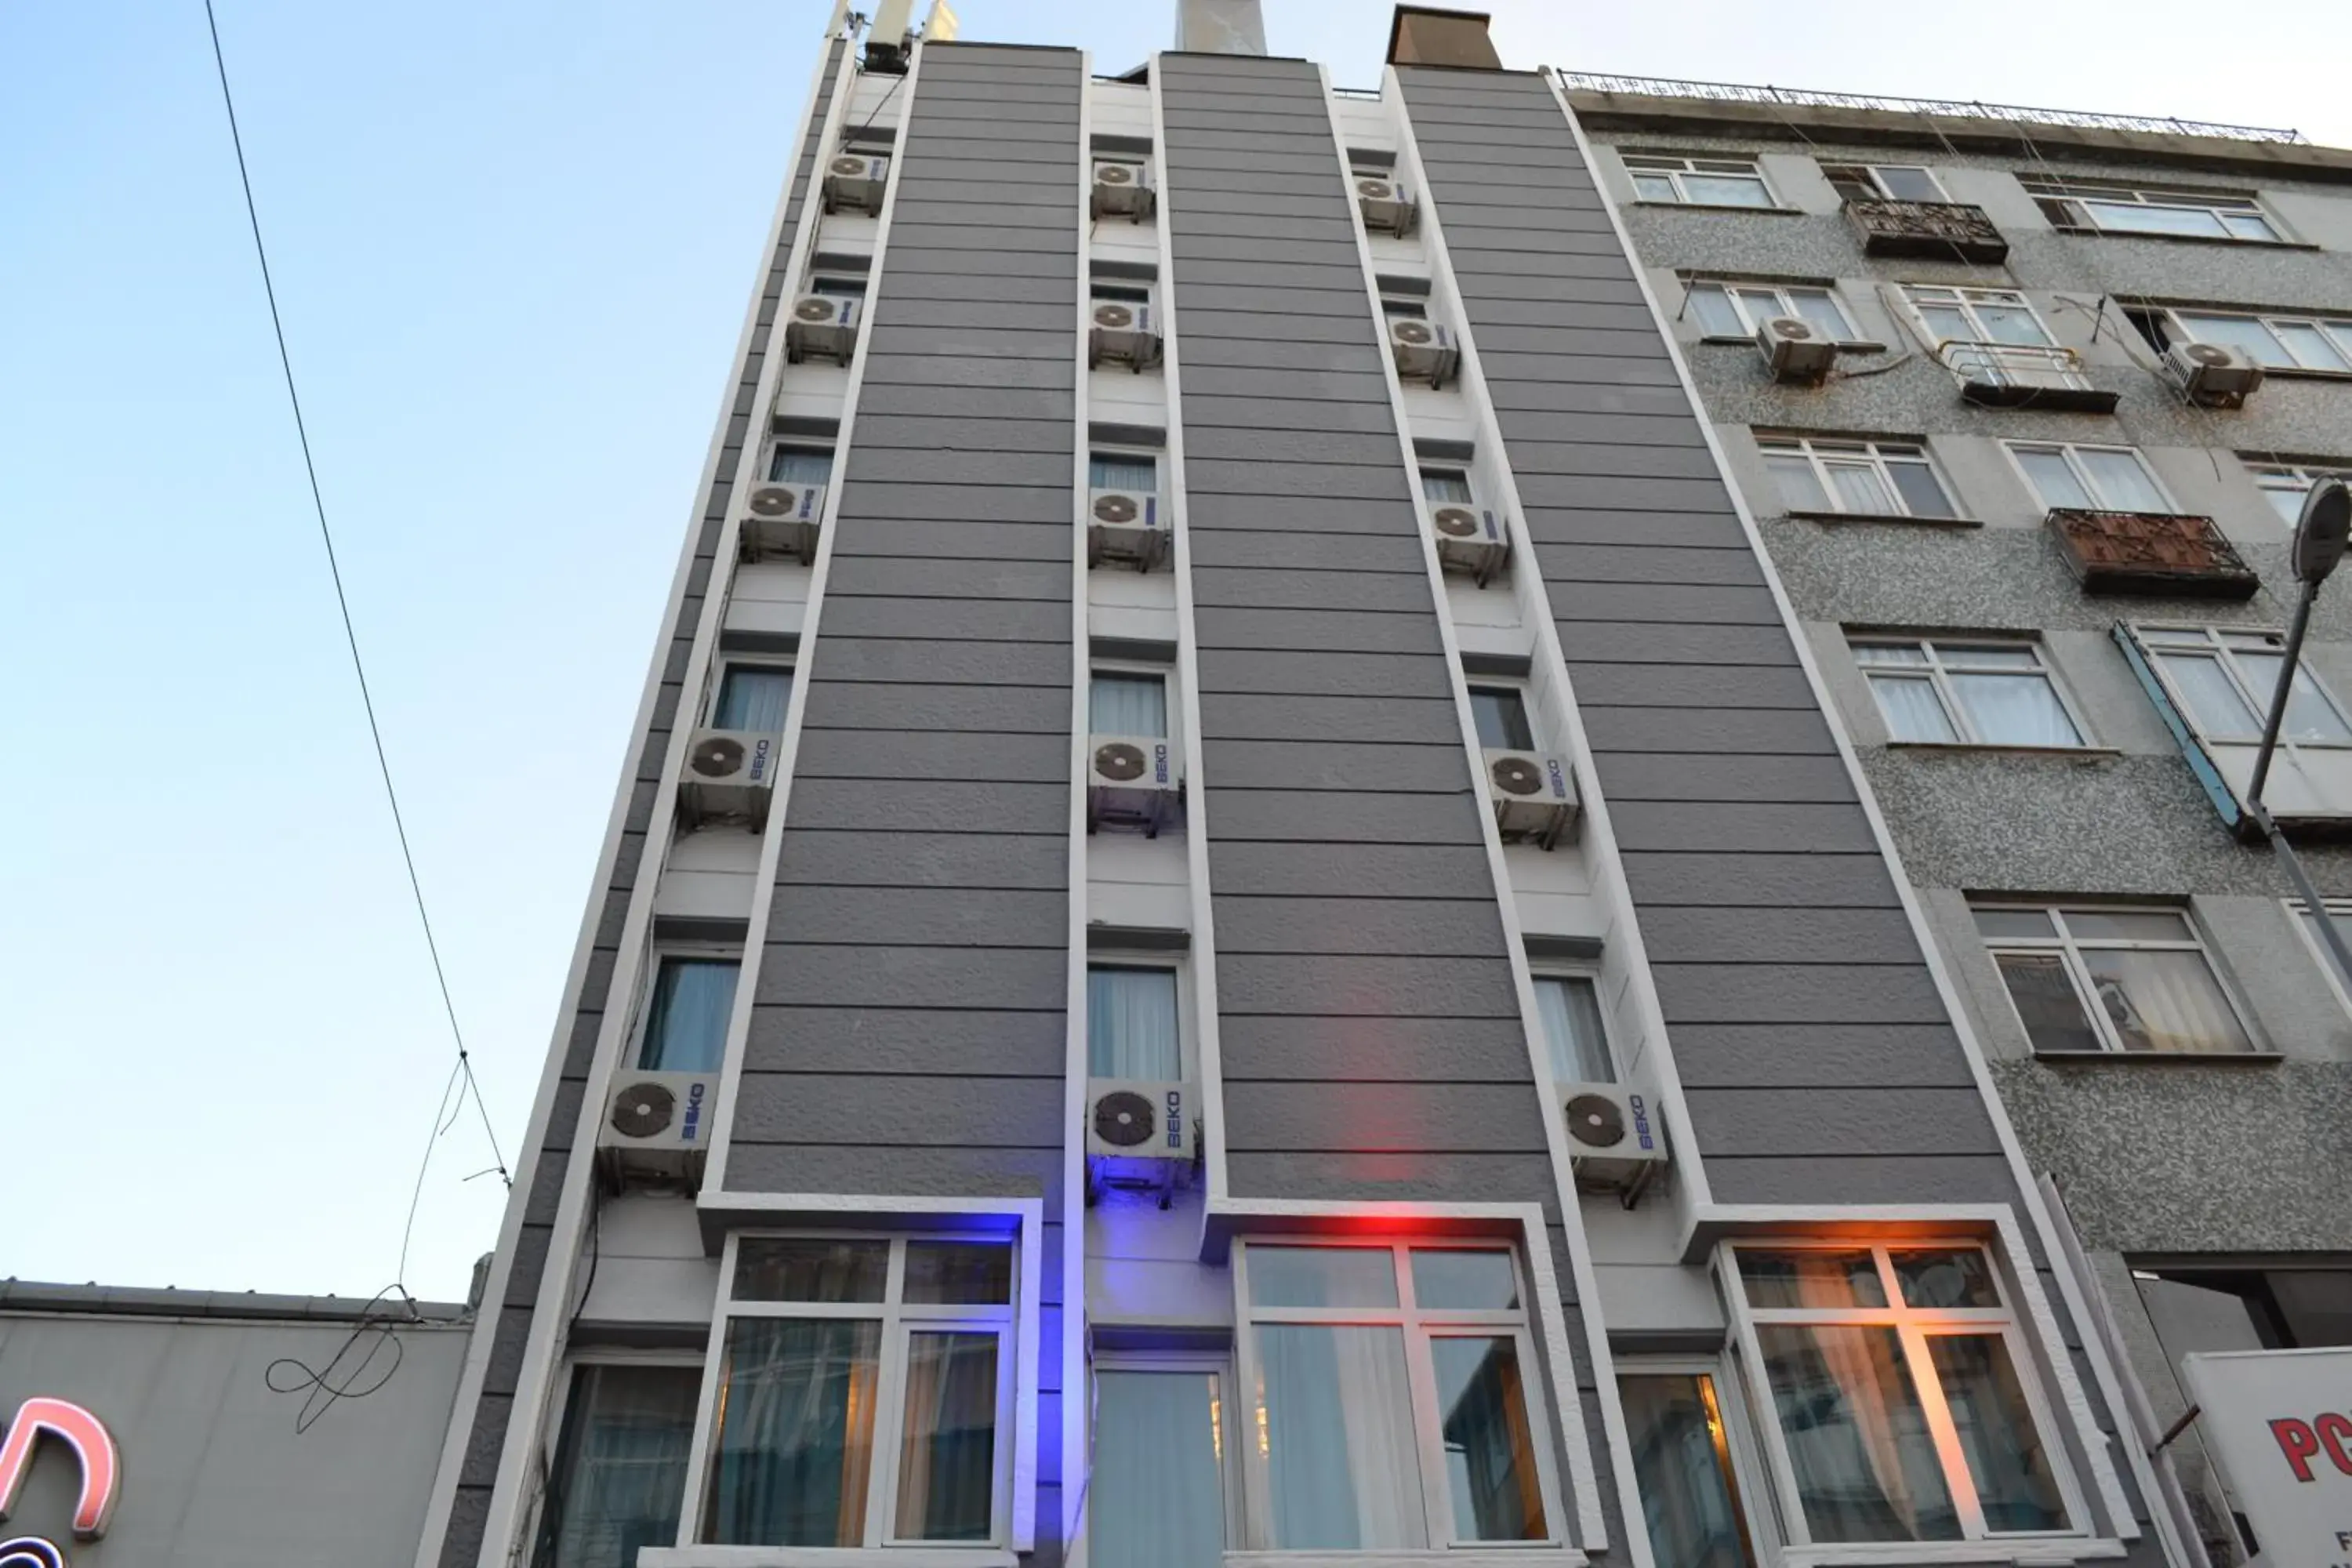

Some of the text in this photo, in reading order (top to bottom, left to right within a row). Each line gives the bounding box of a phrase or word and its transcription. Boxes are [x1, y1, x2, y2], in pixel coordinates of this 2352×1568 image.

[681, 1083, 705, 1139] BEKO
[1167, 1091, 1181, 1148] BEKO
[1629, 1094, 1653, 1150] BEKO
